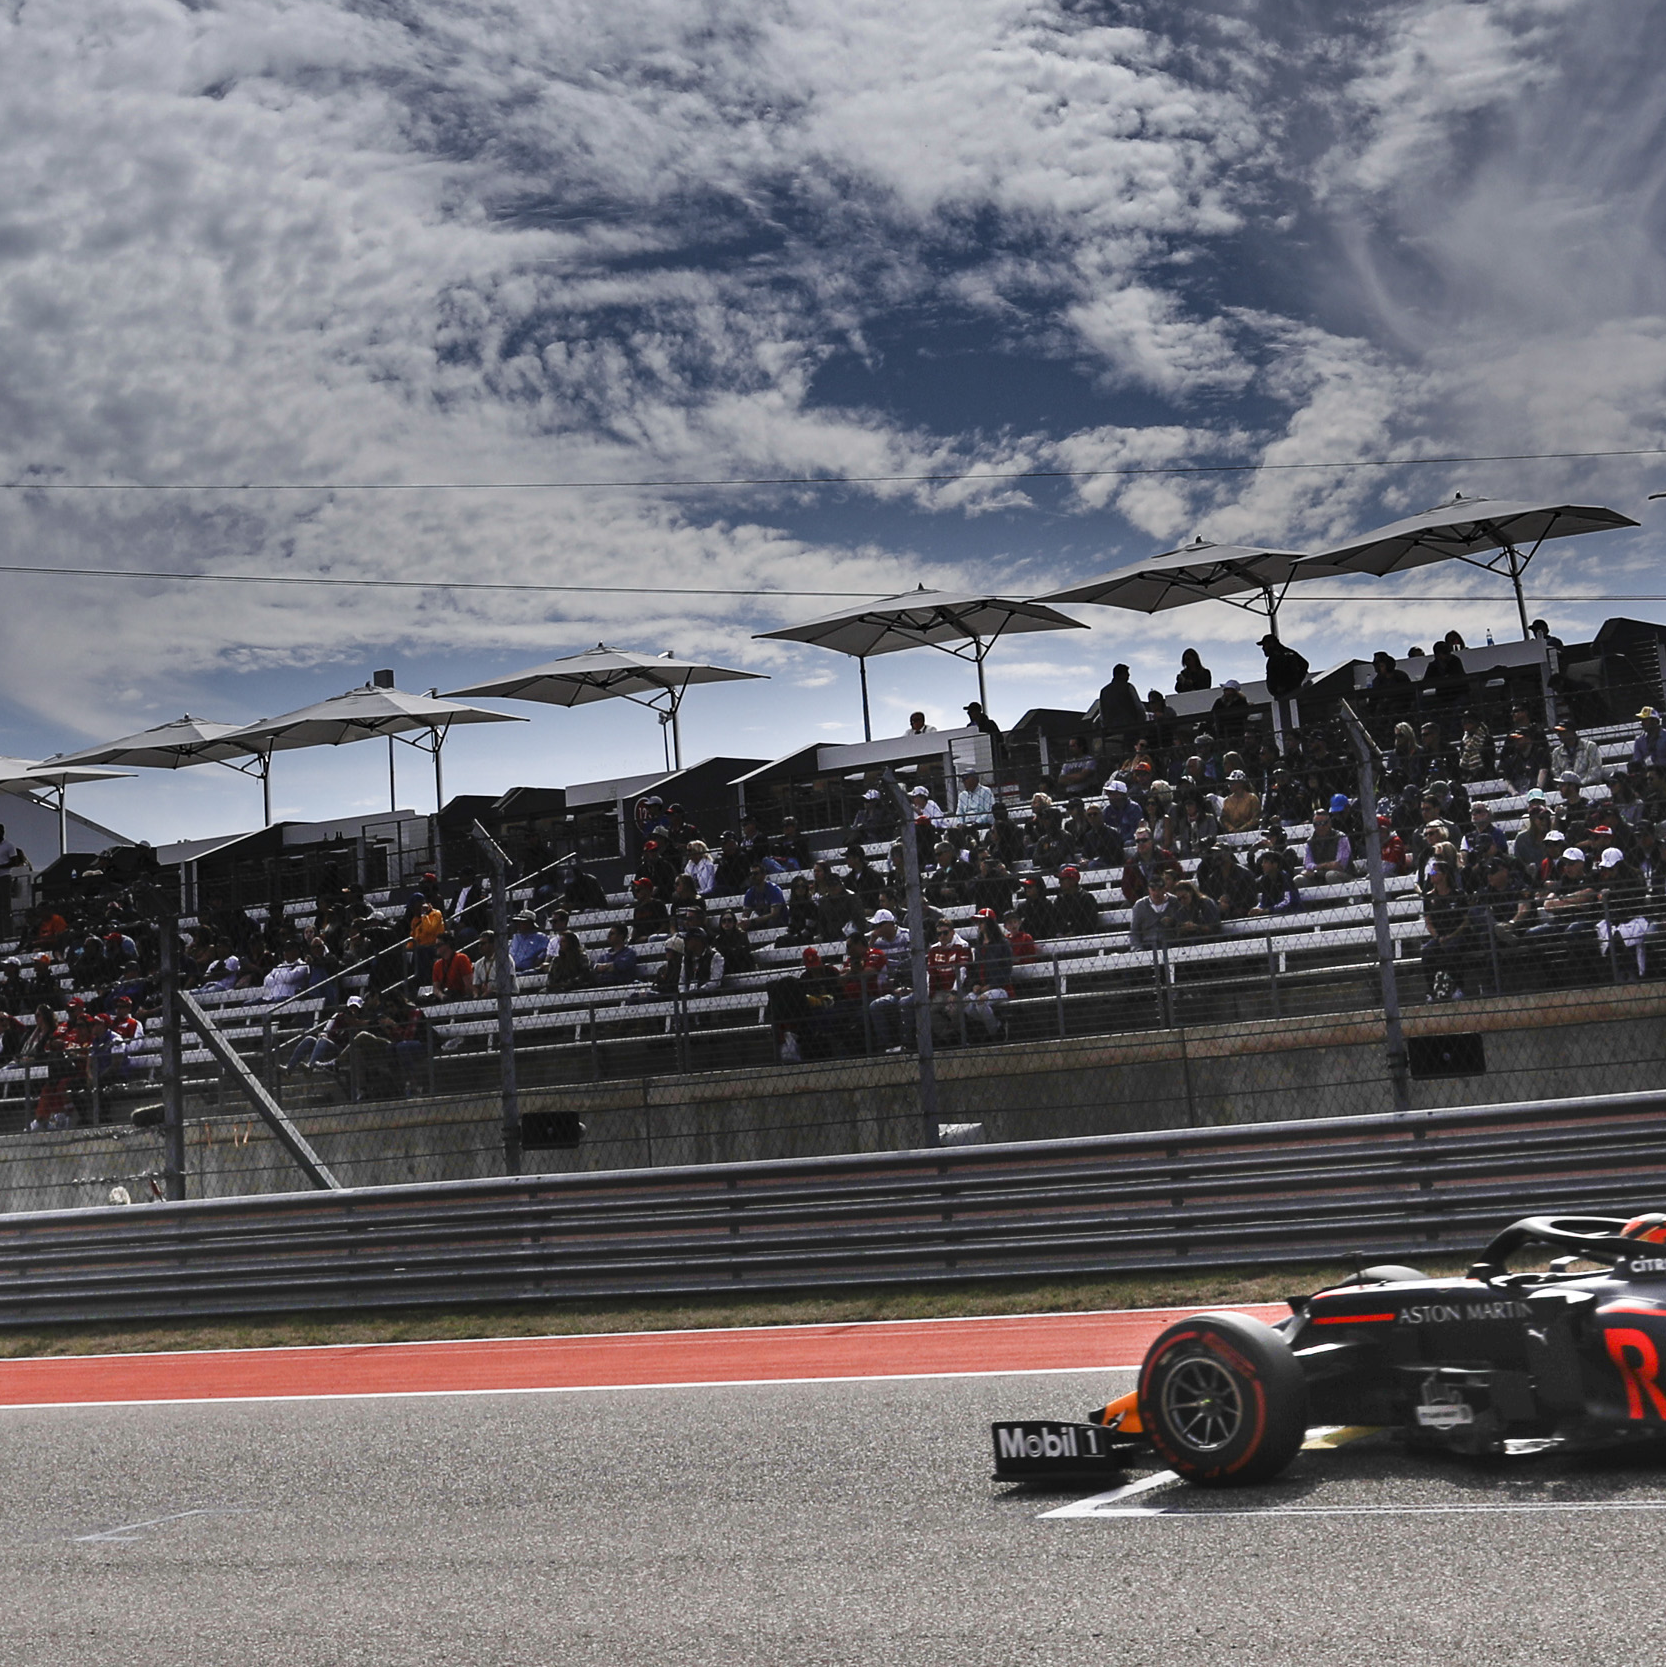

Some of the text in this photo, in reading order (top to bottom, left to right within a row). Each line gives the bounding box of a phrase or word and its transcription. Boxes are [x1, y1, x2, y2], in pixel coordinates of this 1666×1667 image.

[1399, 1301, 1532, 1324] ASTON MARTIN
[998, 1426, 1078, 1458] Mobil
